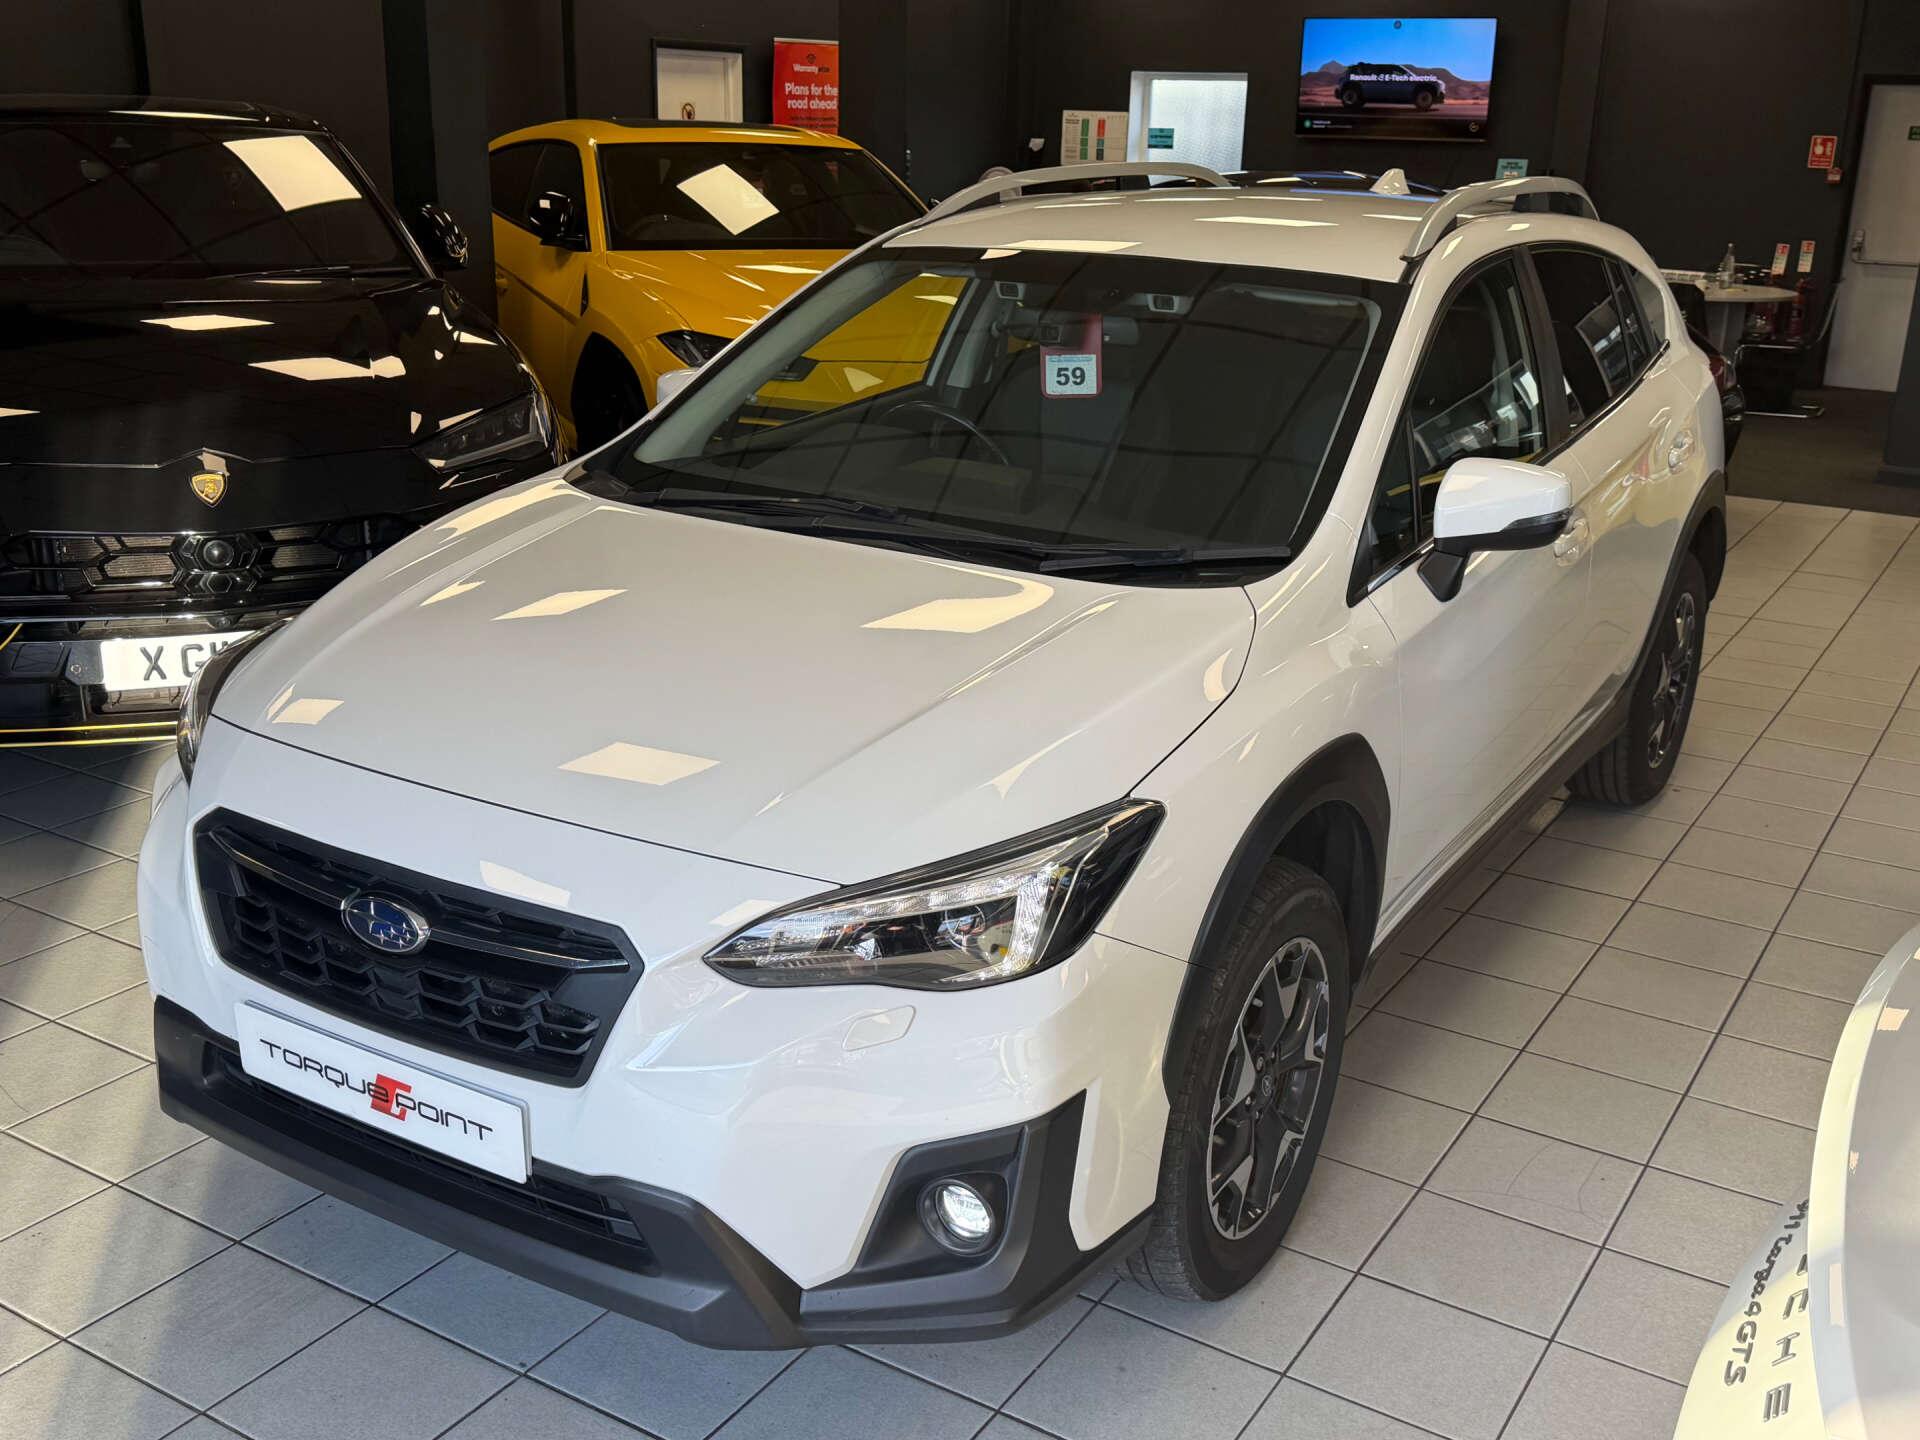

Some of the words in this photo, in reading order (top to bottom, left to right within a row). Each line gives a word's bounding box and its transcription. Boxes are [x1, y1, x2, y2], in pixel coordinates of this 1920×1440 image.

[785, 82, 810, 96] Plans
[811, 84, 823, 96] for
[824, 84, 838, 96] the
[787, 97, 808, 110] road
[810, 98, 838, 110] ahead
[1055, 366, 1086, 386] 59
[139, 645, 167, 681] X
[1724, 1320, 1757, 1386] GTS
